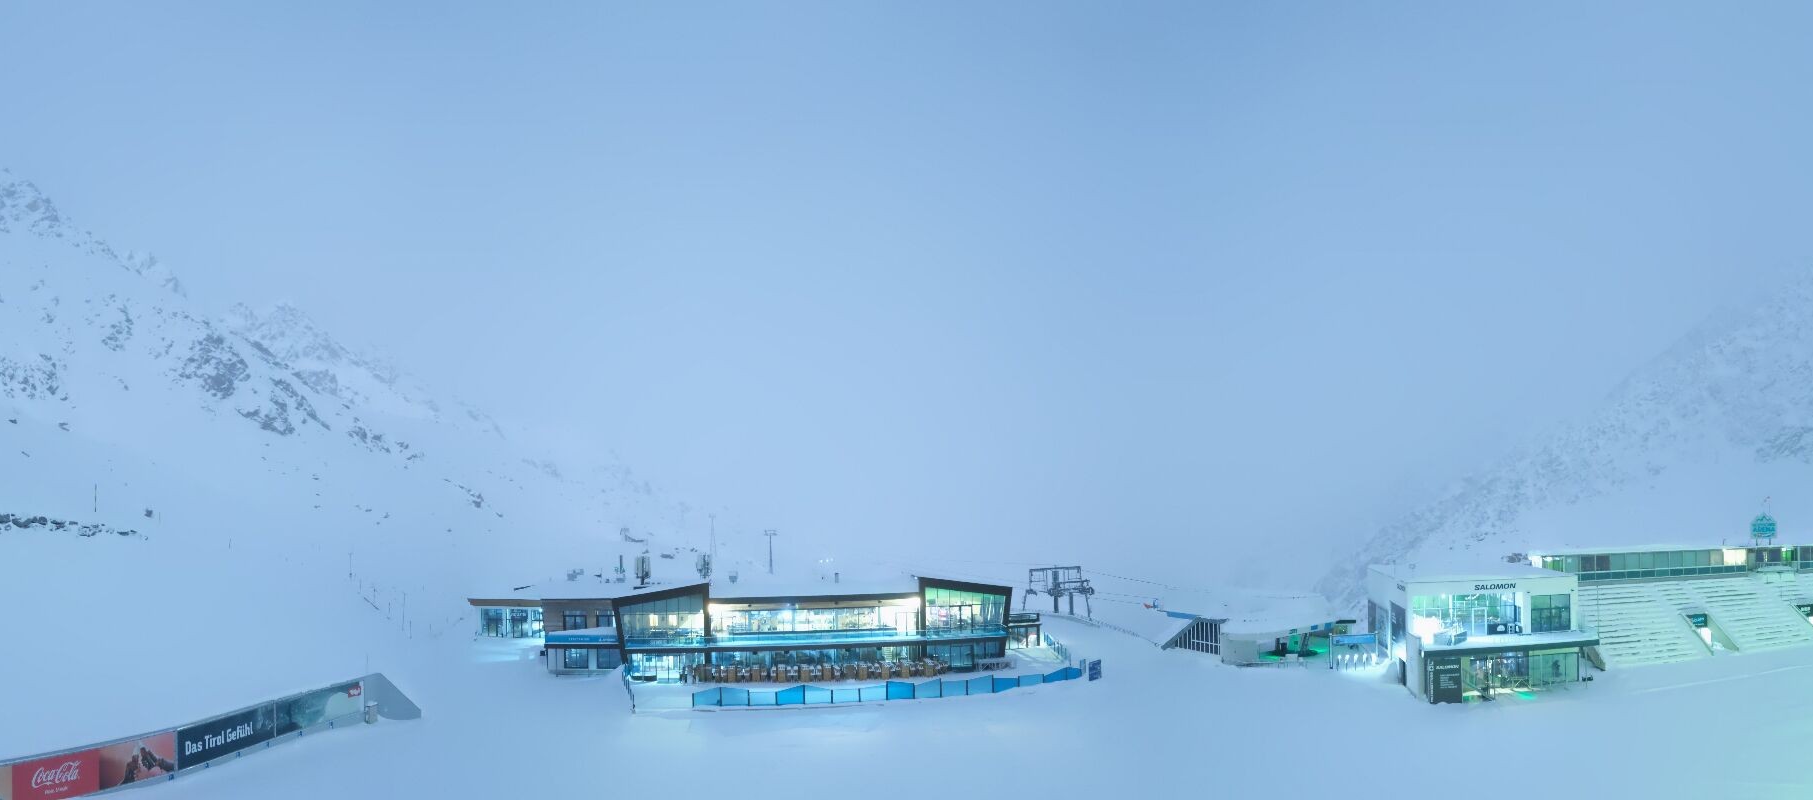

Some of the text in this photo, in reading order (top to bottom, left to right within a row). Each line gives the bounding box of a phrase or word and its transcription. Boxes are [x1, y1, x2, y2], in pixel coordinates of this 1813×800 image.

[1474, 582, 1516, 591] SALOMON
[185, 721, 254, 755] Das Tirol Gefühl
